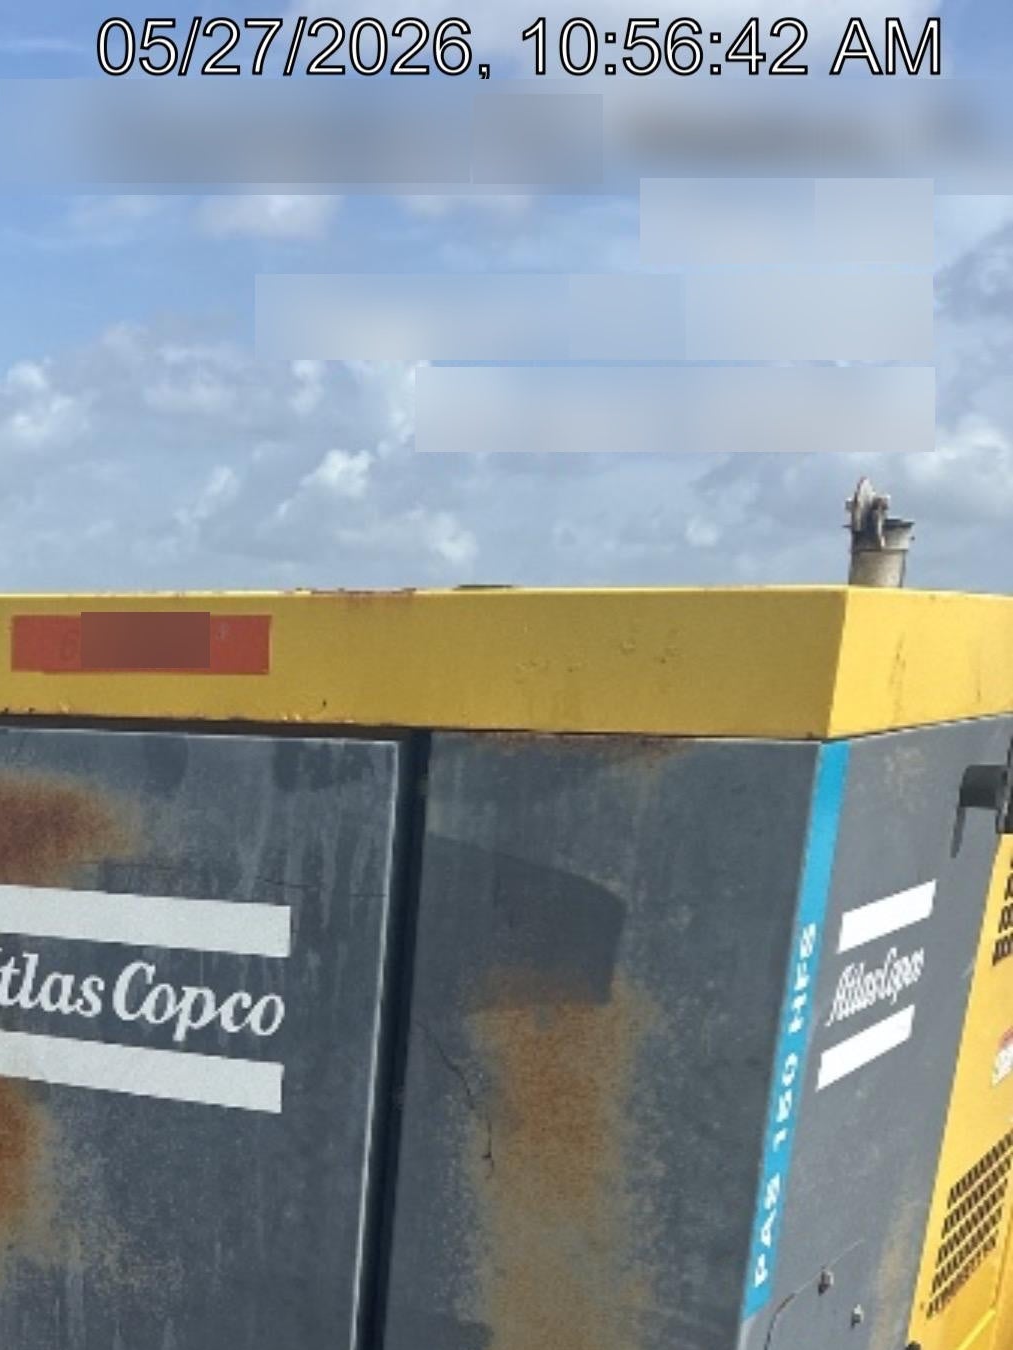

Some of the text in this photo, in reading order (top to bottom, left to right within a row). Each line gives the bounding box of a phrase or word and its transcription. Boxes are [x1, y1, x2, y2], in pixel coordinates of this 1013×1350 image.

[112, 960, 285, 1042] Copco
[754, 922, 817, 1288] PAS 150 HFS
